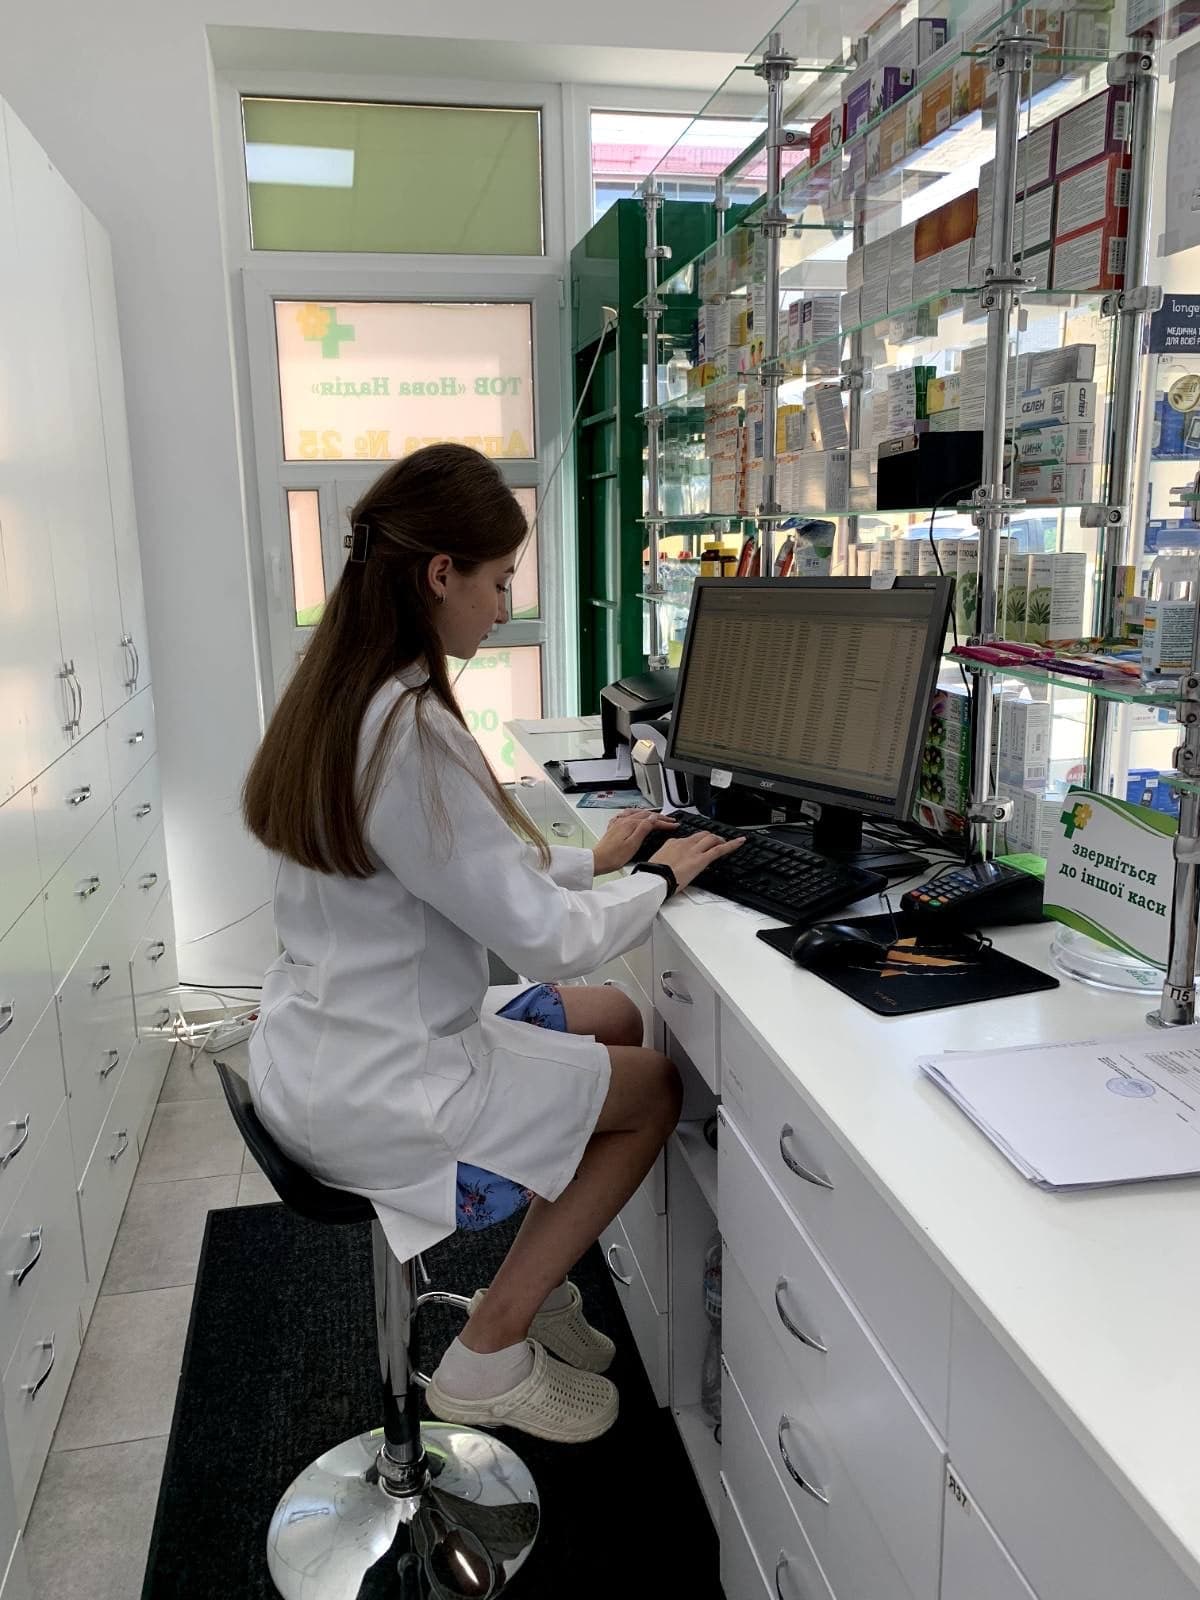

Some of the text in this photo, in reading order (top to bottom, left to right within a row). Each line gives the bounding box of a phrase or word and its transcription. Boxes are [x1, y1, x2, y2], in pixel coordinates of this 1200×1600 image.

[1166, 327, 1197, 336] МЕДИЧНА
[1165, 337, 1179, 346] ДЛЯ
[1022, 400, 1045, 413] СЕЛЕН
[1078, 387, 1087, 418] СЕЛЕН
[1022, 442, 1042, 455] ЦИНК
[1072, 843, 1157, 885] зверніться
[1059, 863, 1167, 916] до іншої каси
[1170, 987, 1190, 1001] П5
